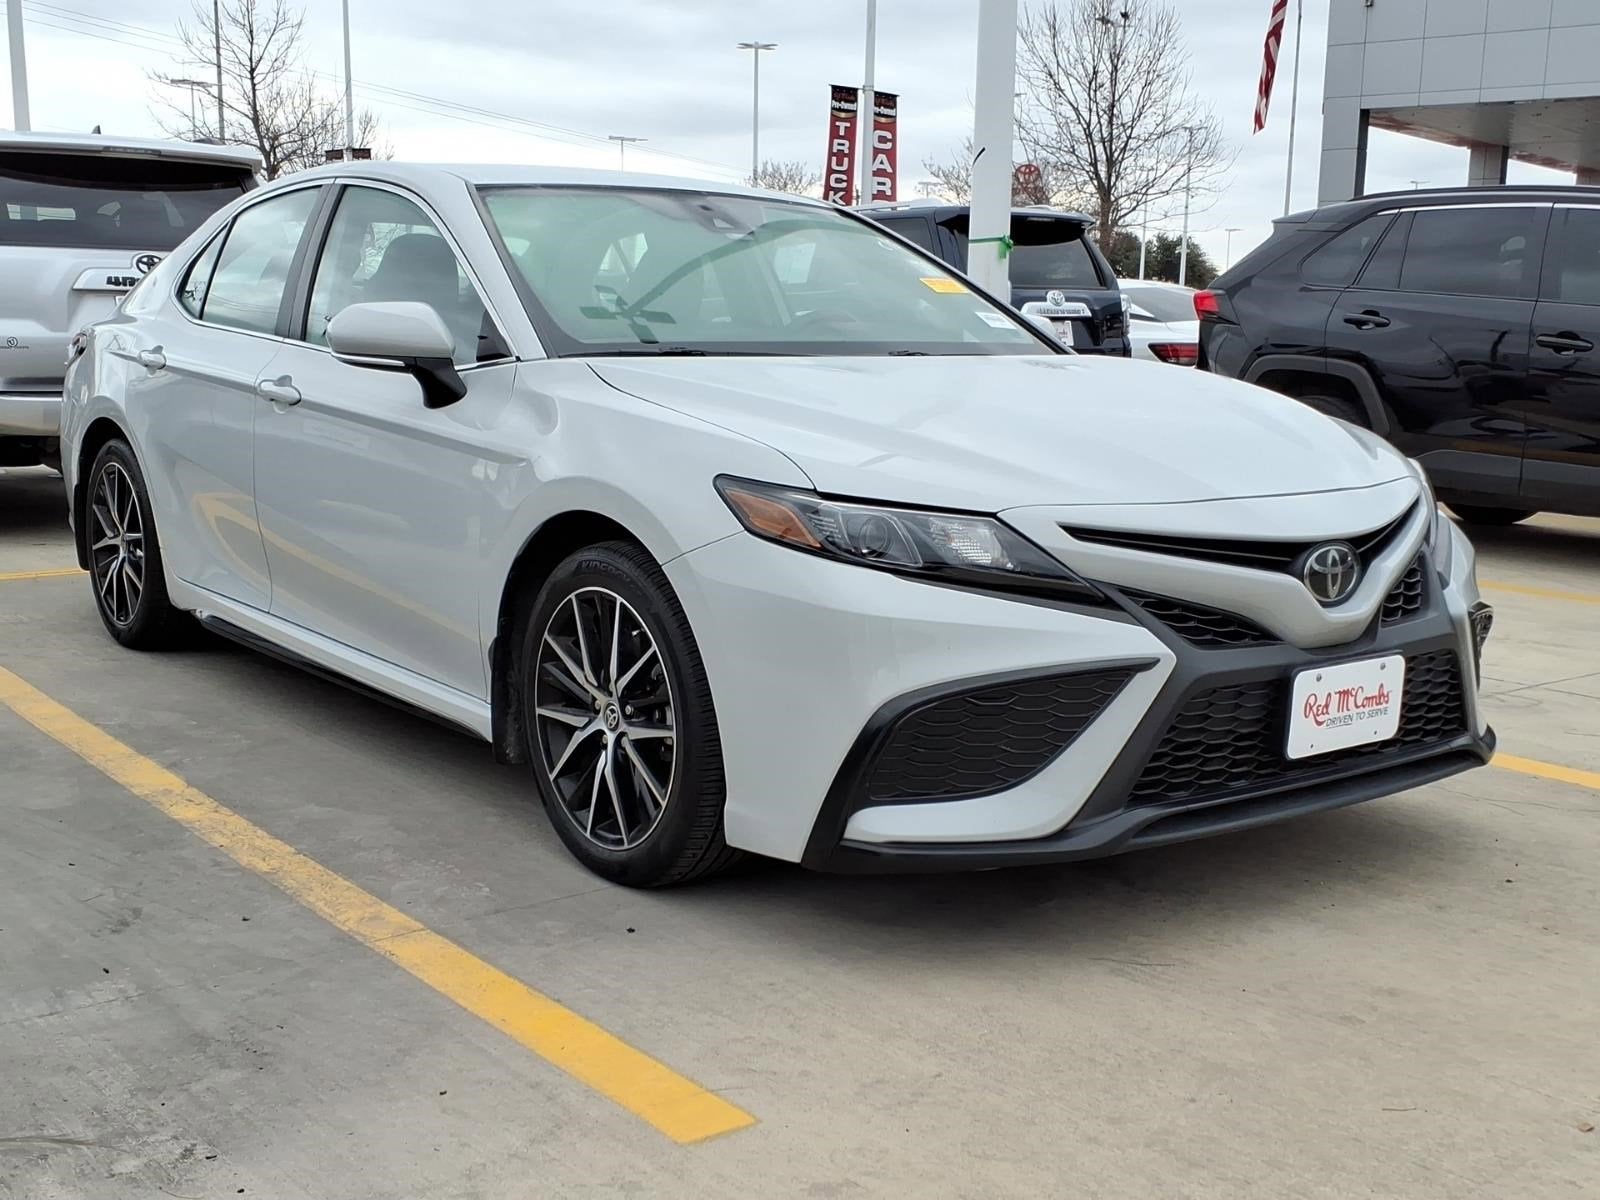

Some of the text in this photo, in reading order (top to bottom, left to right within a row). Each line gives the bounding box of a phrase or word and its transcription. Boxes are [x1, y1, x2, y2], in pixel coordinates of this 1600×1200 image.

[828, 121, 851, 206] TRUCK
[872, 130, 893, 203] CAR
[1304, 683, 1392, 726] Red McCombs
[1326, 707, 1389, 727] DRIVEN TO SERVE
